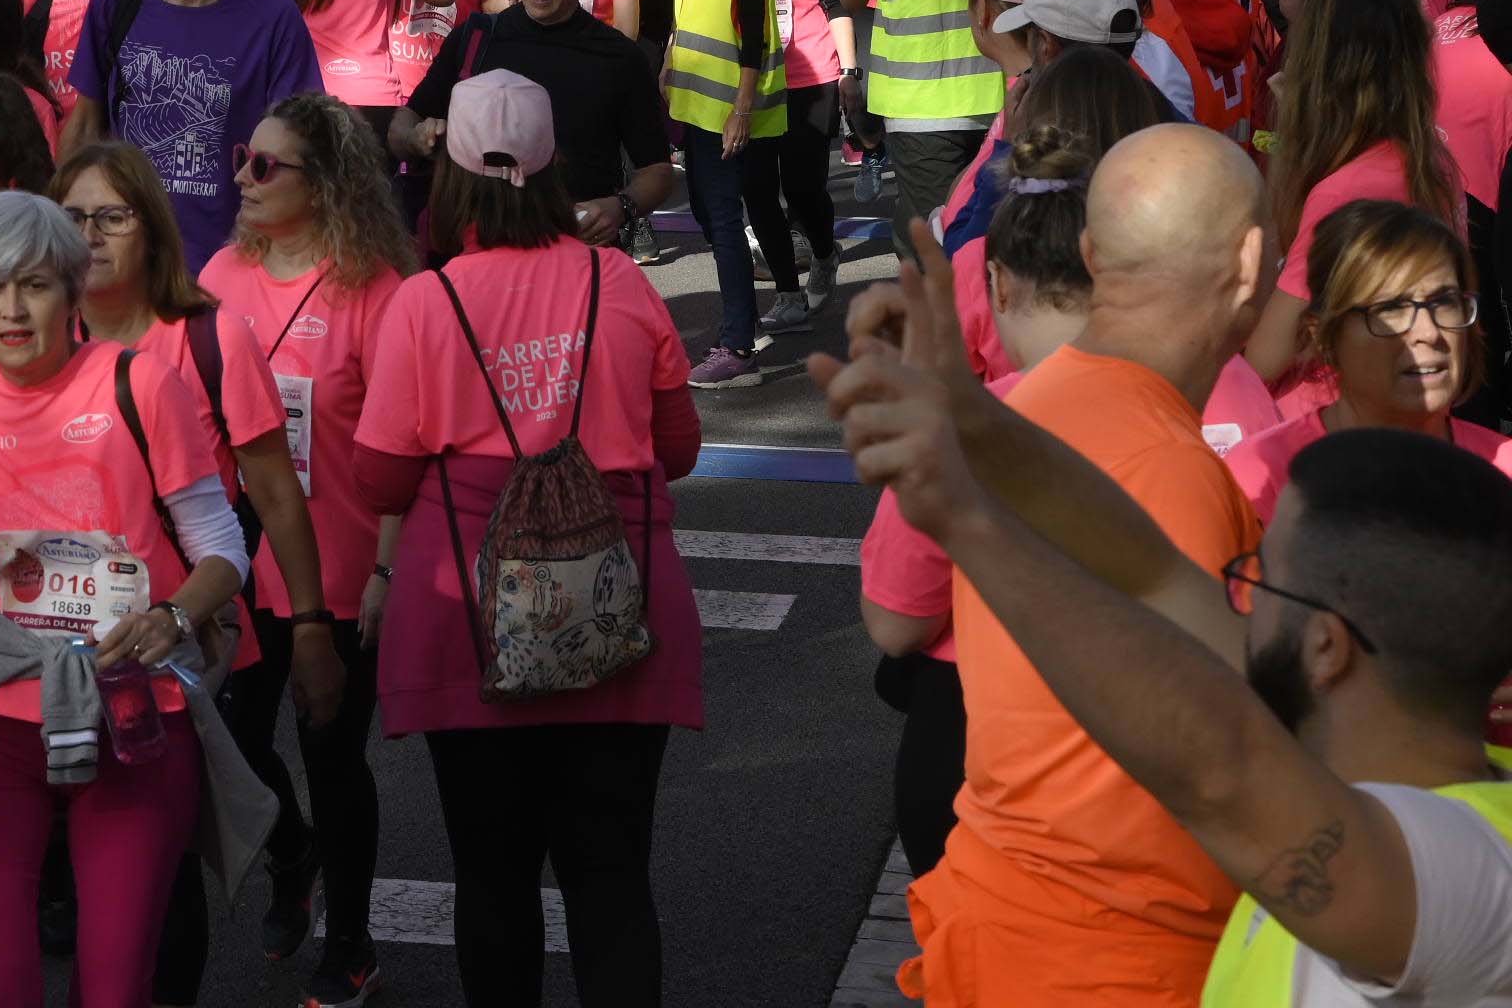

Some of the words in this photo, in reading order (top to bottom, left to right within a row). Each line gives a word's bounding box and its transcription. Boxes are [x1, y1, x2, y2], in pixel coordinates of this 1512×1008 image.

[391, 40, 433, 61] SUM
[172, 178, 218, 197] MONTSERRAT
[481, 328, 586, 372] CARRERA
[502, 367, 535, 391] DE
[545, 359, 573, 384] LA
[499, 381, 580, 415] MUJER
[535, 409, 558, 423] 2023
[42, 545, 97, 561] ASTURIANA
[48, 572, 97, 597] 016
[50, 599, 92, 616] 18639
[13, 615, 51, 627] CARRERA
[53, 619, 65, 628] DE
[67, 621, 79, 630] LA
